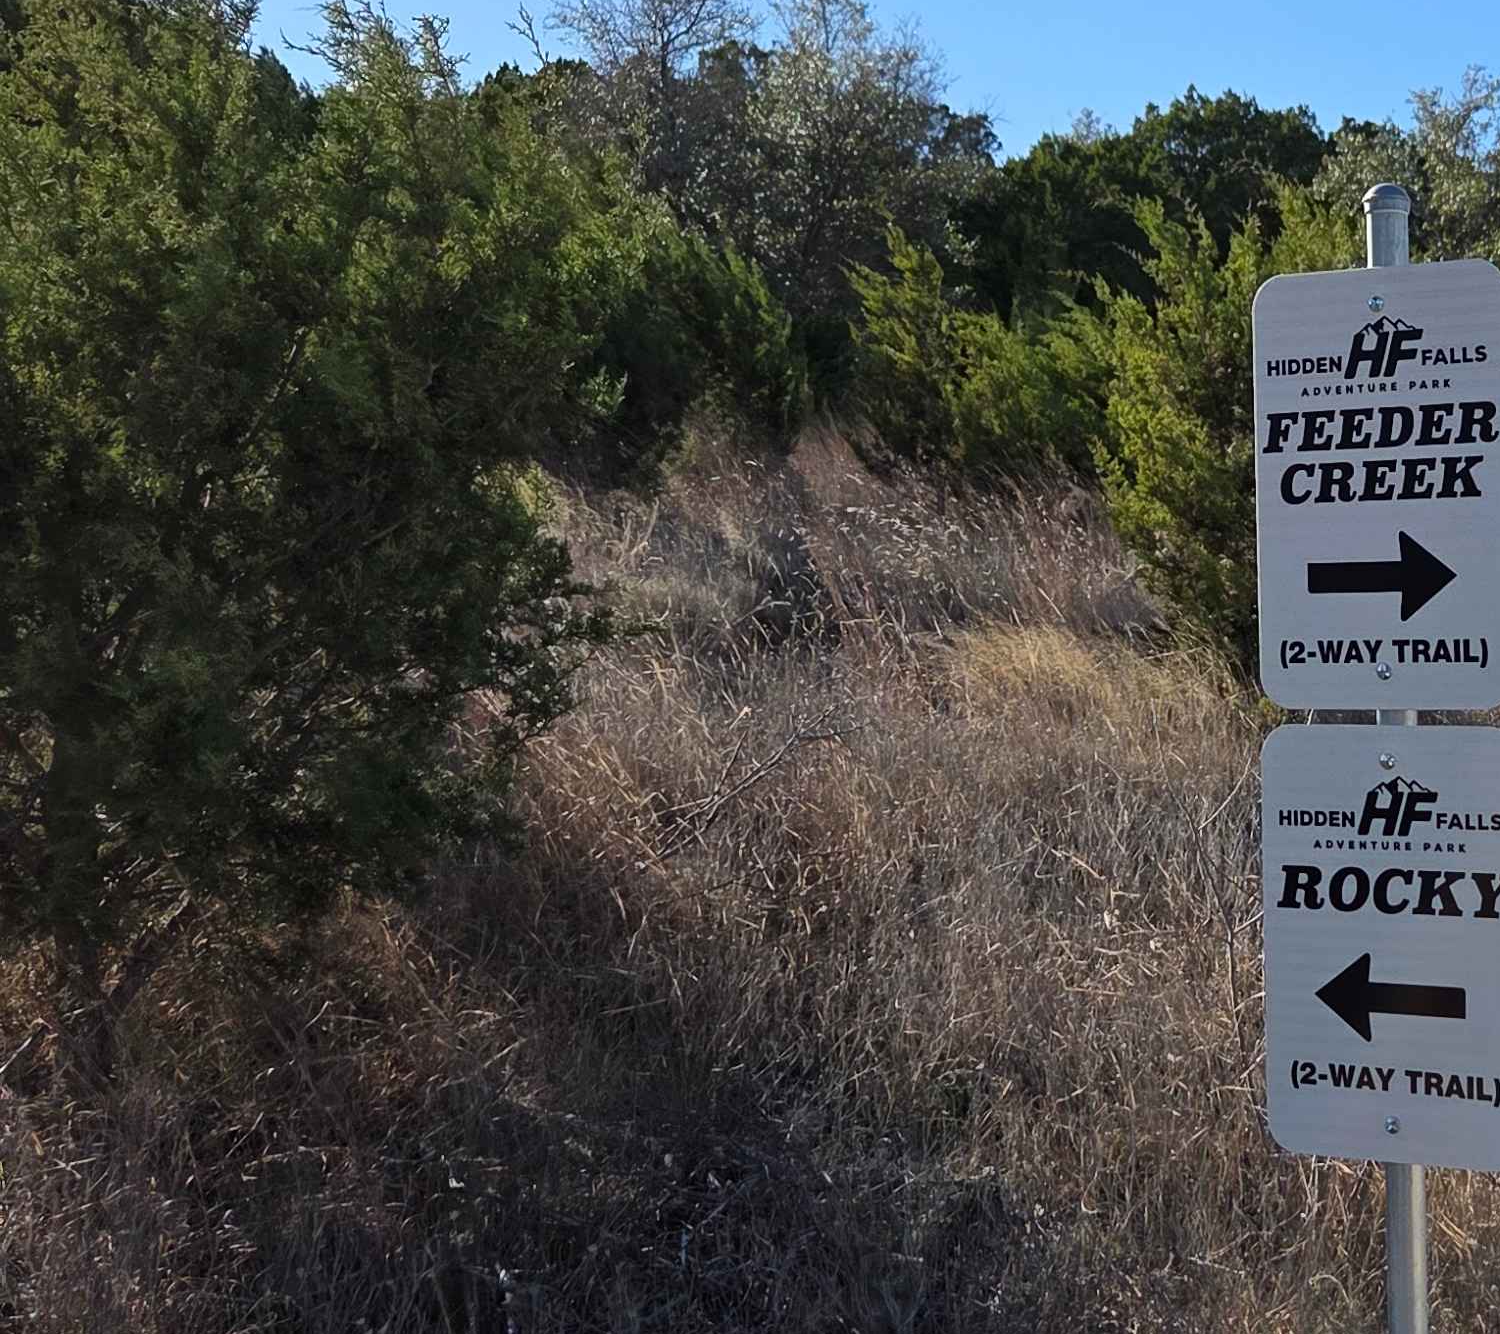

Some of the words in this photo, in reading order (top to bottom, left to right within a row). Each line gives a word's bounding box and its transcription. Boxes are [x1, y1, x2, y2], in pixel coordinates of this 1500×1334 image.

[1266, 355, 1343, 377] HIDDEN
[1344, 327, 1424, 380] HF
[1421, 345, 1488, 366] FALLS
[1301, 381, 1398, 397] ADVENTURE
[1408, 378, 1452, 392] PARK
[1262, 401, 1500, 454] FEEDER
[1280, 455, 1485, 505] CREEK
[1280, 639, 1383, 669] (2-WAY
[1392, 637, 1489, 668] TRAIL)
[1278, 810, 1356, 828] HIDDEN
[1357, 791, 1438, 837] HF
[1313, 840, 1412, 852] ADVENTURE
[1423, 842, 1467, 854] PARK
[1290, 1059, 1395, 1092] (2-WAY
